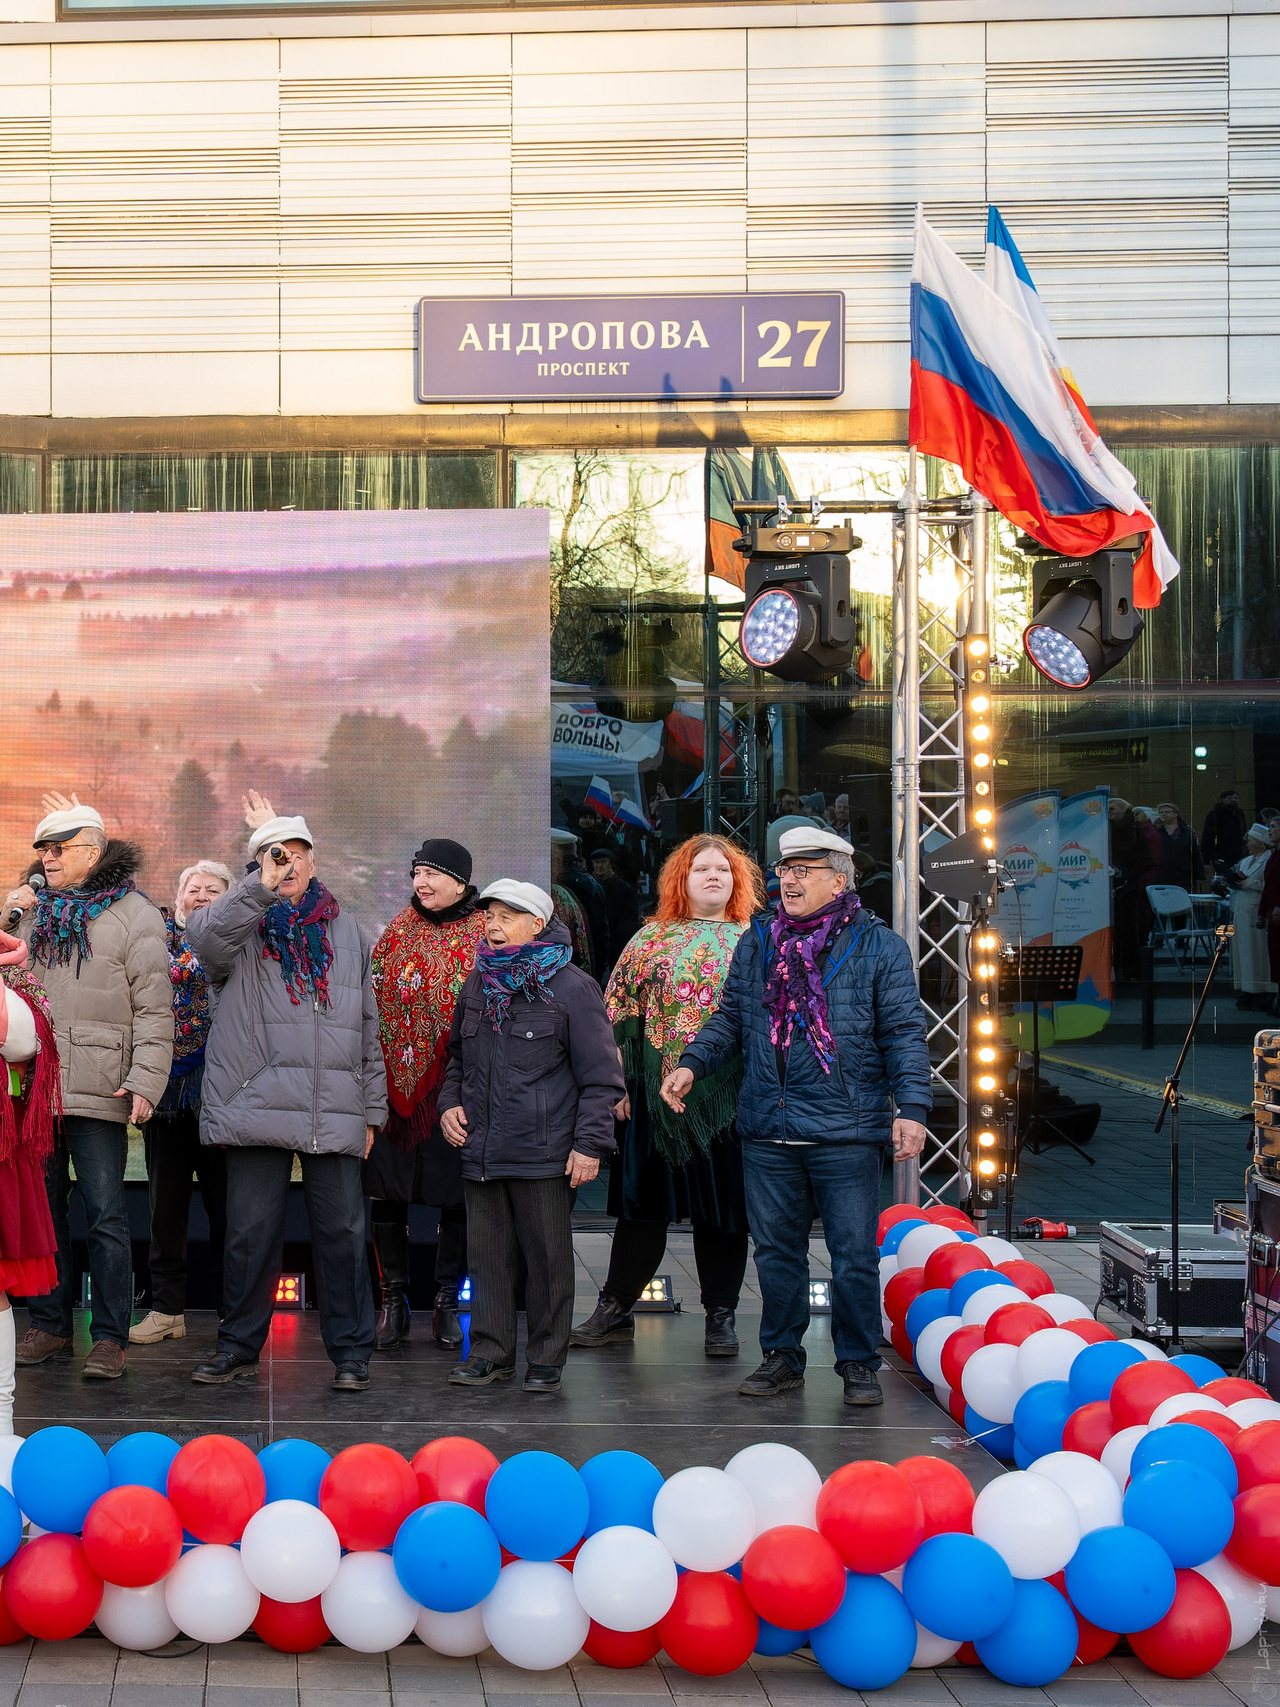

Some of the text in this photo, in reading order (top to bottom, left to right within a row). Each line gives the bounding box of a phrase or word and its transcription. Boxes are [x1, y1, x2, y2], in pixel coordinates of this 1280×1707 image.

[458, 319, 832, 368] АНДРОПОВА 27
[537, 362, 630, 377] ПРОСПЕКТ
[556, 713, 623, 736] ДОБРО
[553, 727, 620, 754] ВОЛЬЦЫ
[1003, 859, 1034, 871] МИР
[1058, 855, 1087, 867] МИР
